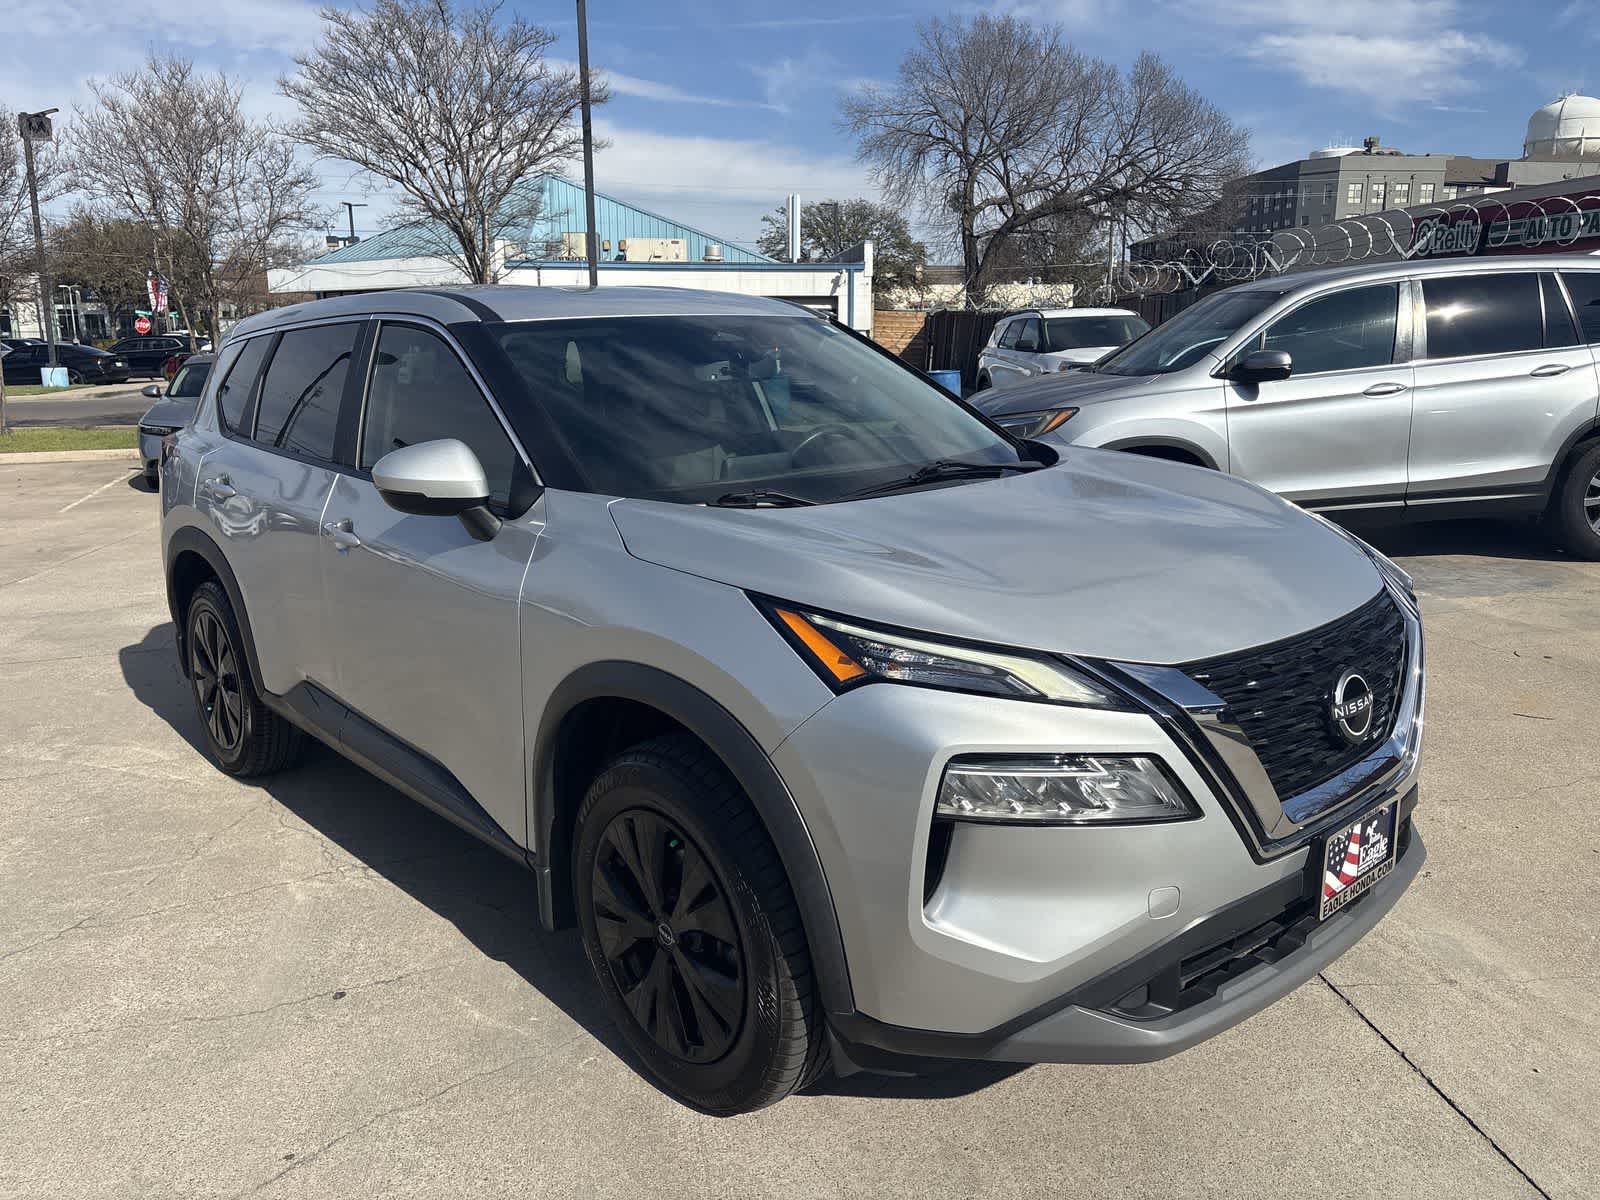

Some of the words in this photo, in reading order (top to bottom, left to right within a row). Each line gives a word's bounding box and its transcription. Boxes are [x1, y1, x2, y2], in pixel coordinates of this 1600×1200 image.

[1415, 219, 1482, 256] O'Reilly
[1526, 215, 1572, 240] AUTO
[135, 321, 150, 329] STOP
[1335, 690, 1374, 718] NISSAN
[1359, 834, 1388, 867] Eagle
[1322, 890, 1348, 918] EAGLE
